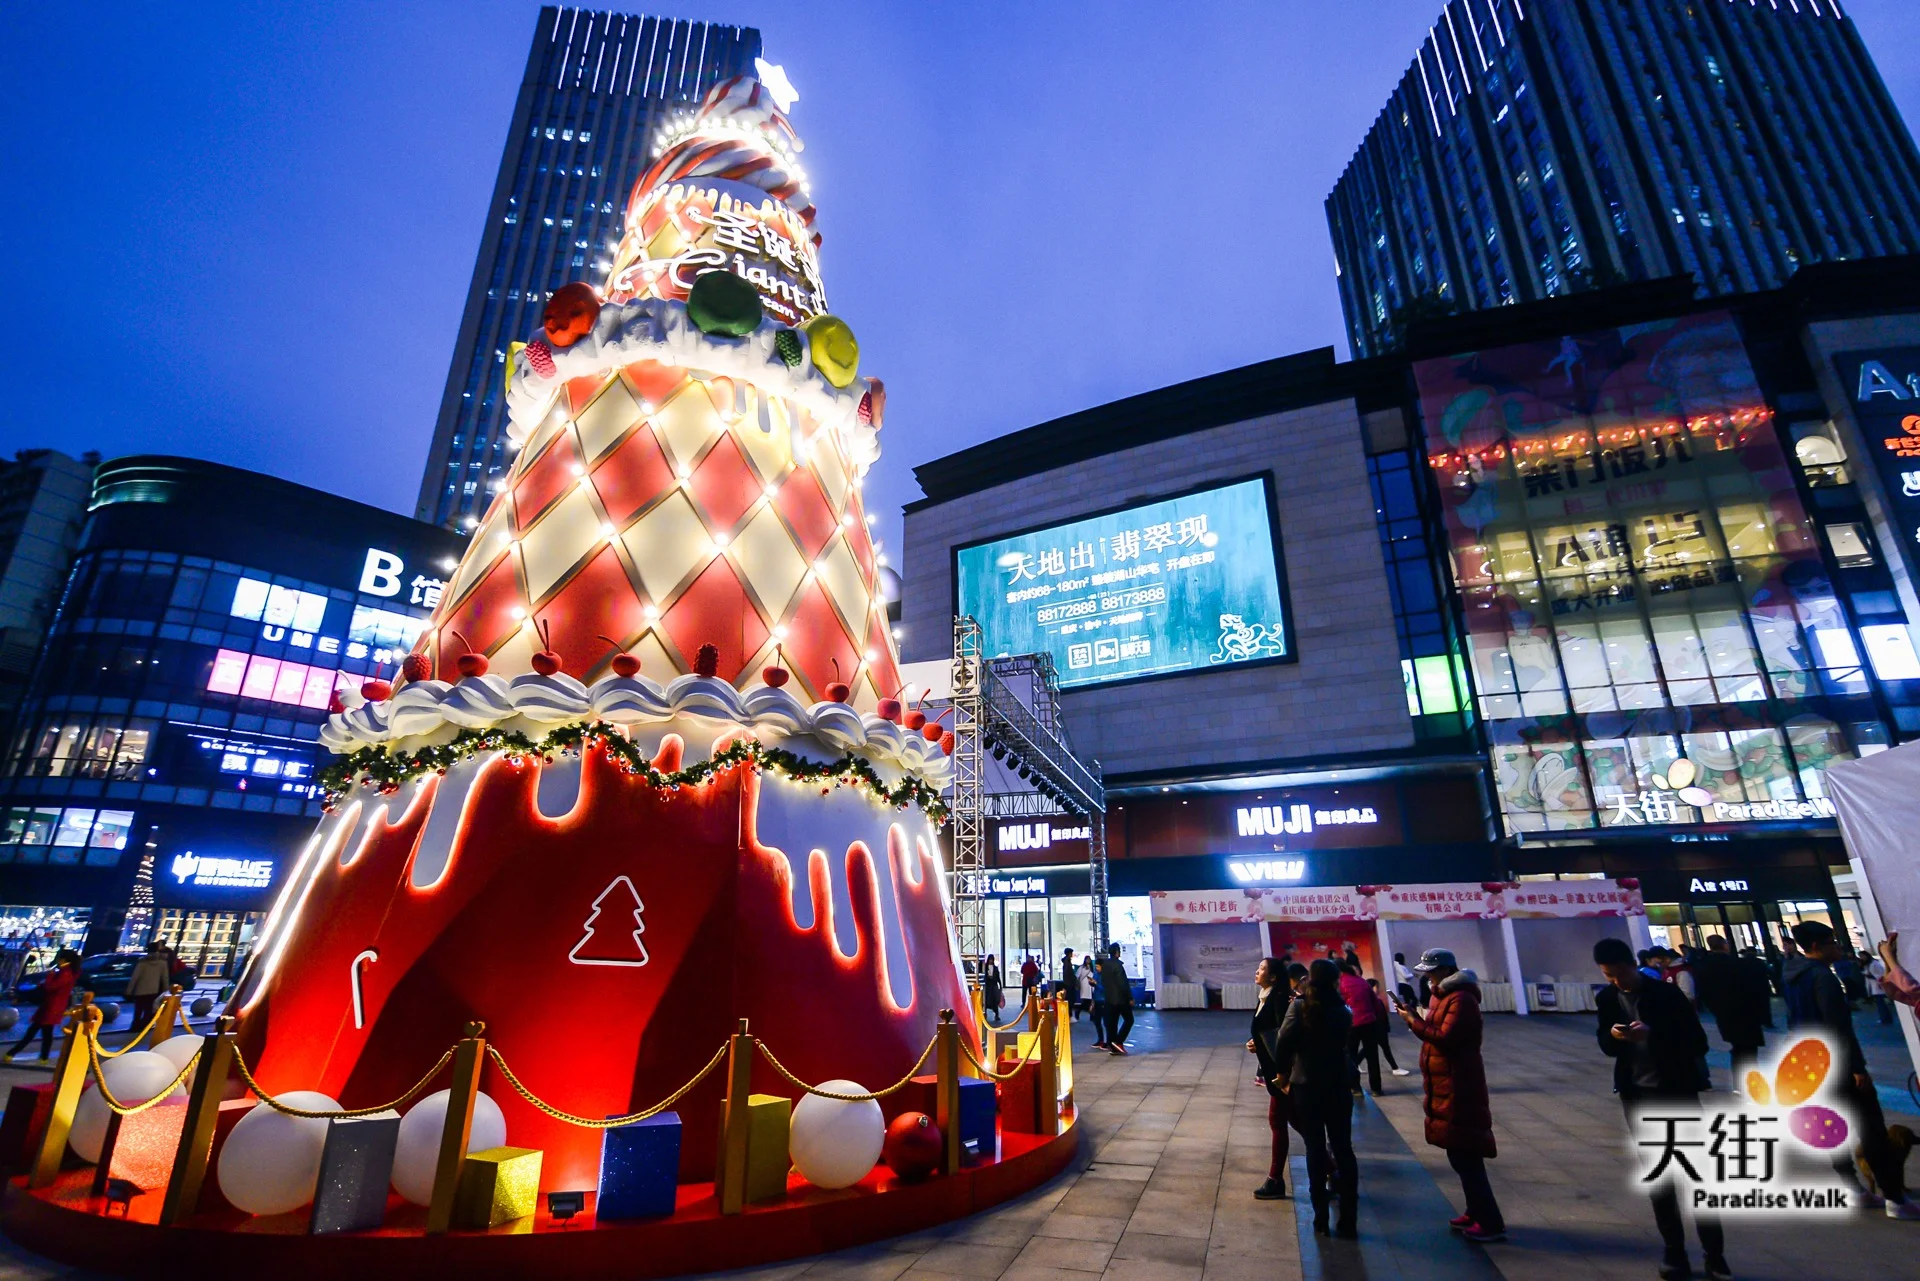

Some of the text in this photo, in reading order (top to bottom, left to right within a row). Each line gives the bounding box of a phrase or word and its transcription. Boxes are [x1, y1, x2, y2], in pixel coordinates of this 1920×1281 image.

[1236, 804, 1312, 836] MUJI
[1605, 790, 1679, 824] 天街
[1712, 799, 1812, 819] Paradise
[998, 822, 1050, 851] MUJI
[1187, 899, 1238, 914] 东水门老街
[1425, 902, 1462, 913] 有限公司
